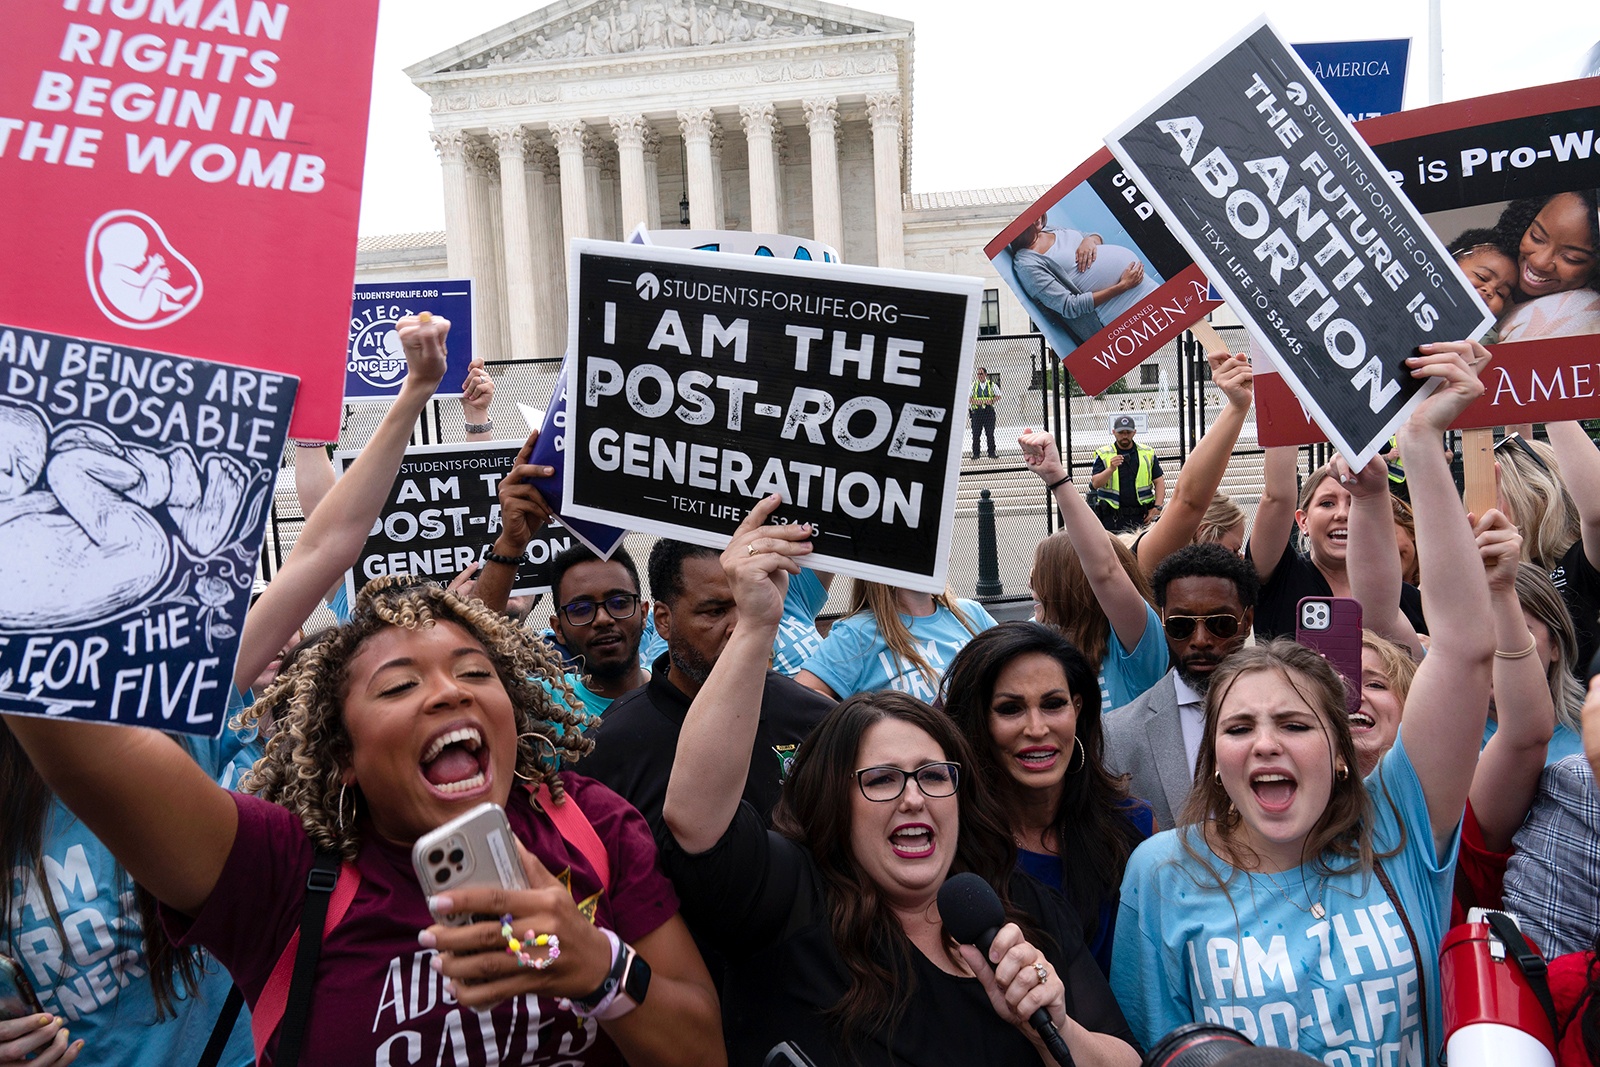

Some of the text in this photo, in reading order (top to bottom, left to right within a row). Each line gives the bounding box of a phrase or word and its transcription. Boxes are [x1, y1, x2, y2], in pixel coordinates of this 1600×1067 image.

[58, 22, 281, 88] RIGHTS
[32, 70, 295, 140] BEGIN IN
[125, 132, 327, 194] WOMB
[1417, 156, 1449, 185] is
[1460, 129, 1600, 178] Pro-W
[1243, 155, 1374, 307] ANTI-
[1244, 72, 1304, 149] THE
[1300, 151, 1410, 292] FUTURE
[1406, 291, 1440, 333] IS
[1304, 104, 1444, 288] STUDENTSFORLIFE.ORG
[1155, 115, 1402, 415] ABORTION
[1201, 220, 1303, 355] TEXT LIFE TO 53445
[663, 278, 899, 324] STUDENTSFORLIFE.ORG
[1092, 296, 1187, 371] WOMEN
[1107, 303, 1155, 341] CONCERNED
[362, 331, 384, 348] AT
[603, 301, 925, 388] I AM THE
[7, 366, 275, 460] DISPOSABLE
[60, 343, 195, 396] BEINGS
[205, 368, 284, 413] ARE
[585, 355, 947, 463] POST-ROE
[1490, 363, 1600, 407] AME
[396, 476, 461, 504] AM
[588, 426, 924, 530] GENERATION
[671, 495, 706, 514] TEXT
[709, 505, 741, 522] LIFE
[17, 636, 110, 690] FOR
[121, 605, 190, 656] THE
[109, 657, 220, 724] FIVE
[1206, 935, 1298, 1000] AM
[1306, 901, 1414, 981] THE
